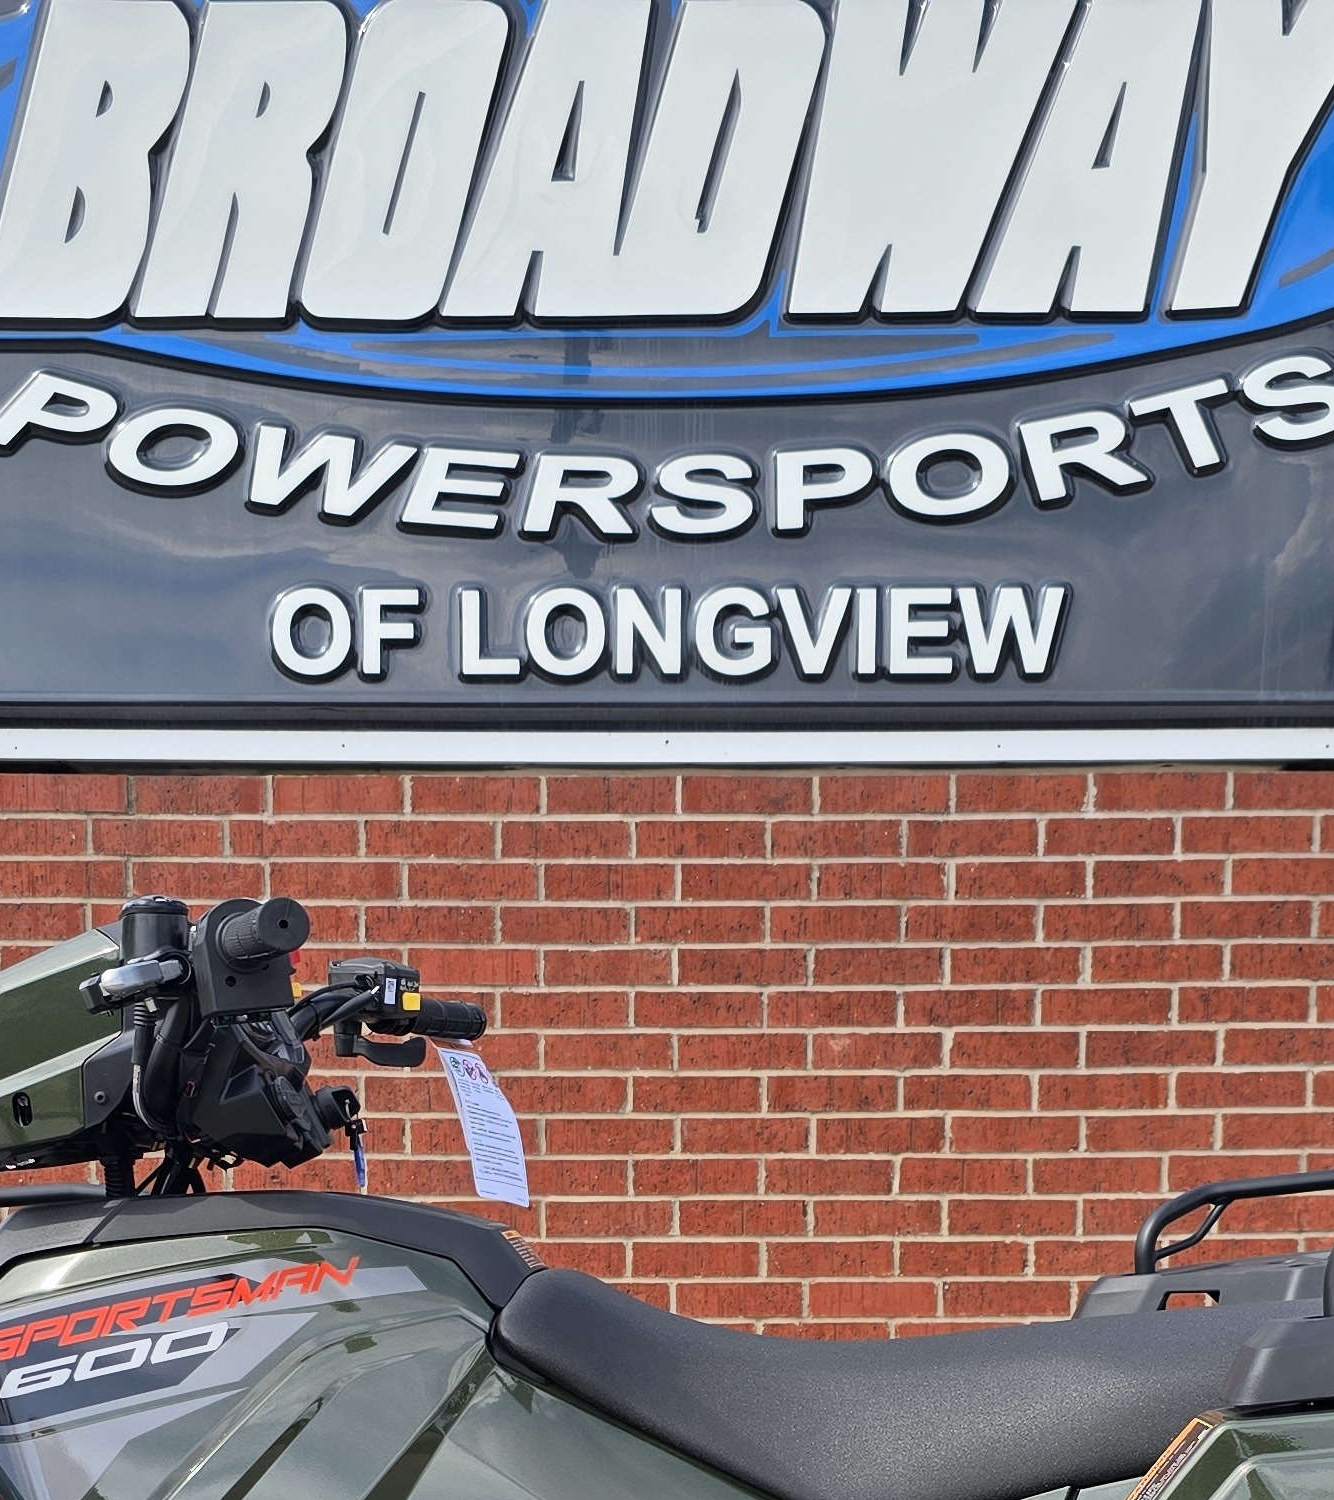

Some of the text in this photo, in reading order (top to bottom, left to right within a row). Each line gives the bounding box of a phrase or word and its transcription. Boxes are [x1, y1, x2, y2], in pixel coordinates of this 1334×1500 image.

[272, 586, 1068, 677] OF LONGVIEW
[0, 1322, 229, 1399] 600
